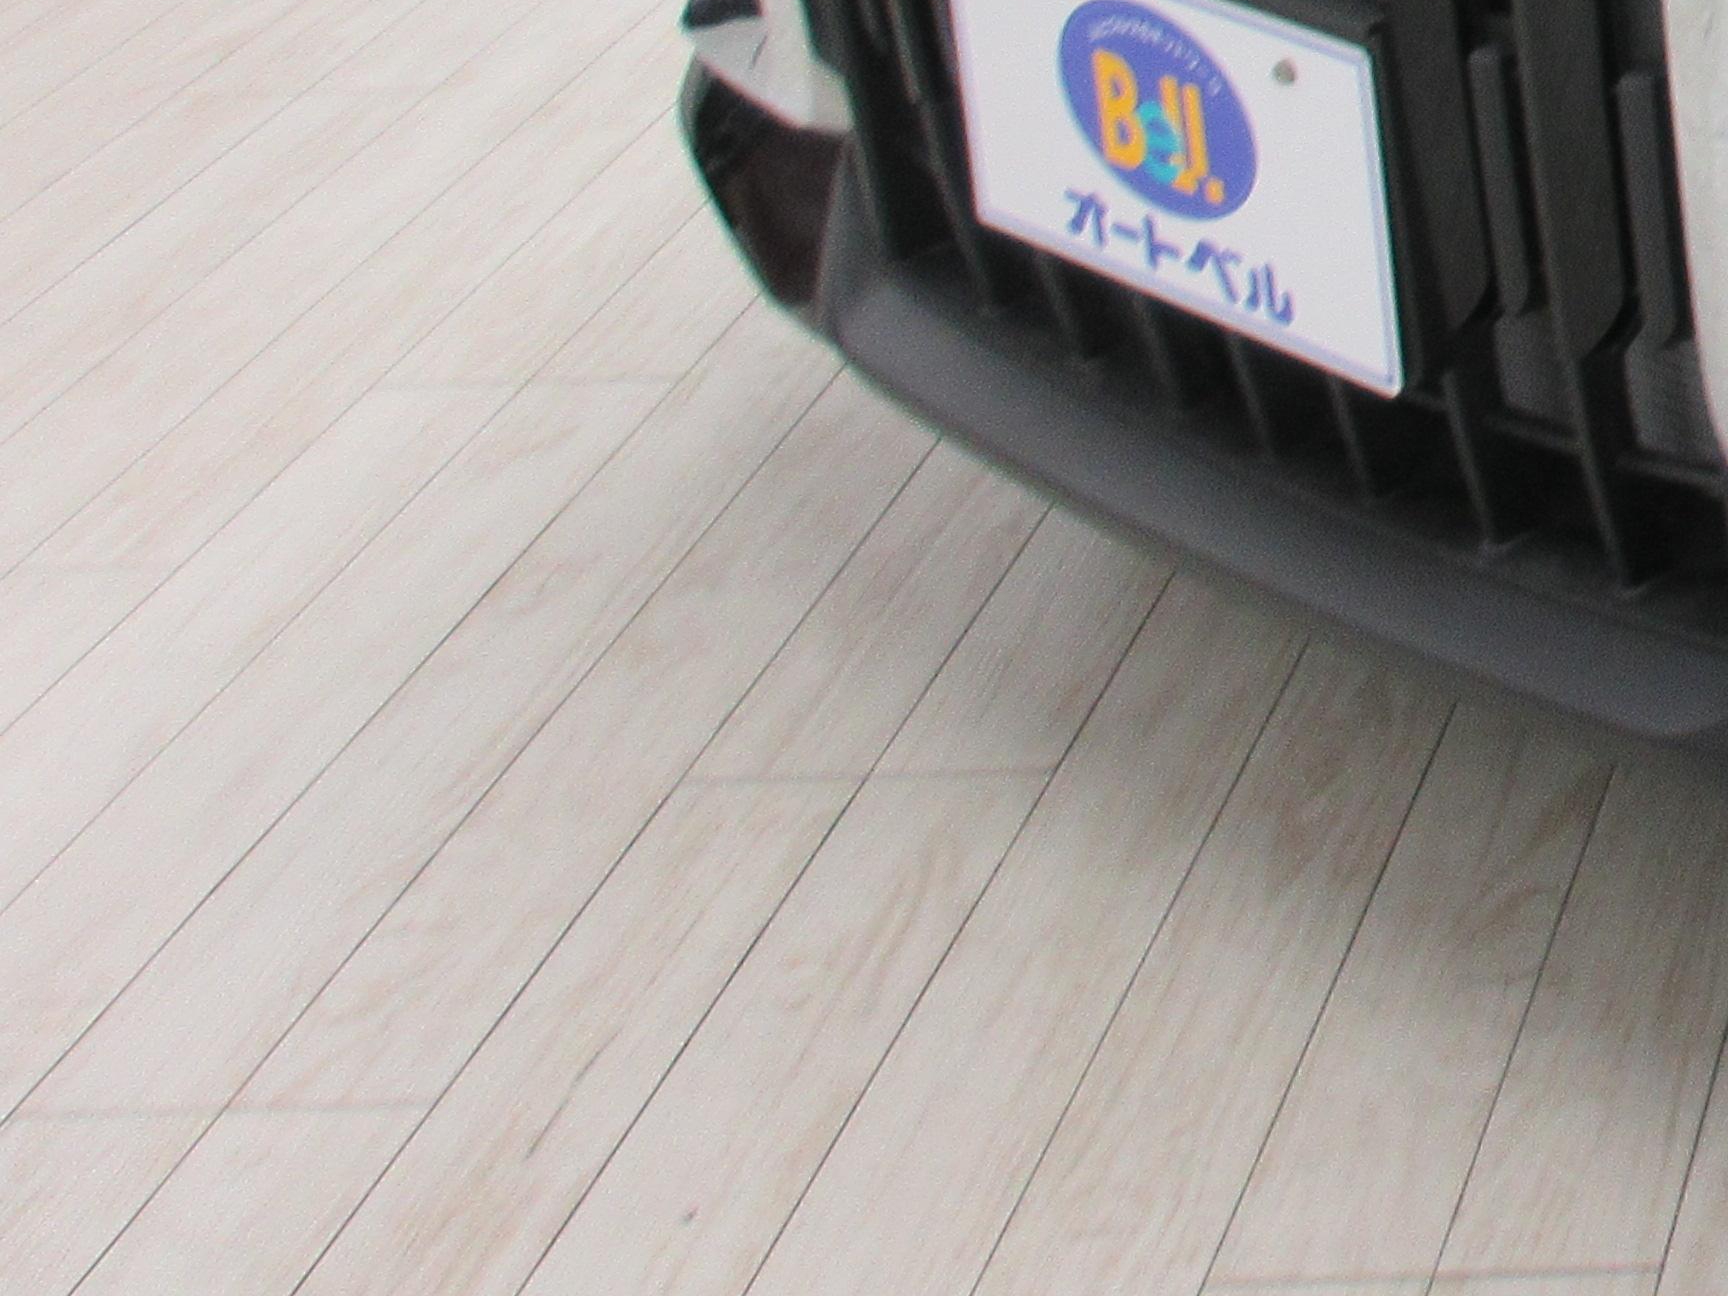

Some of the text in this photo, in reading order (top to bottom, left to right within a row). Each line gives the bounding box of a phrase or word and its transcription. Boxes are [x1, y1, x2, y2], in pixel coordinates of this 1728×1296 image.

[1063, 185, 1295, 327] オートベル
